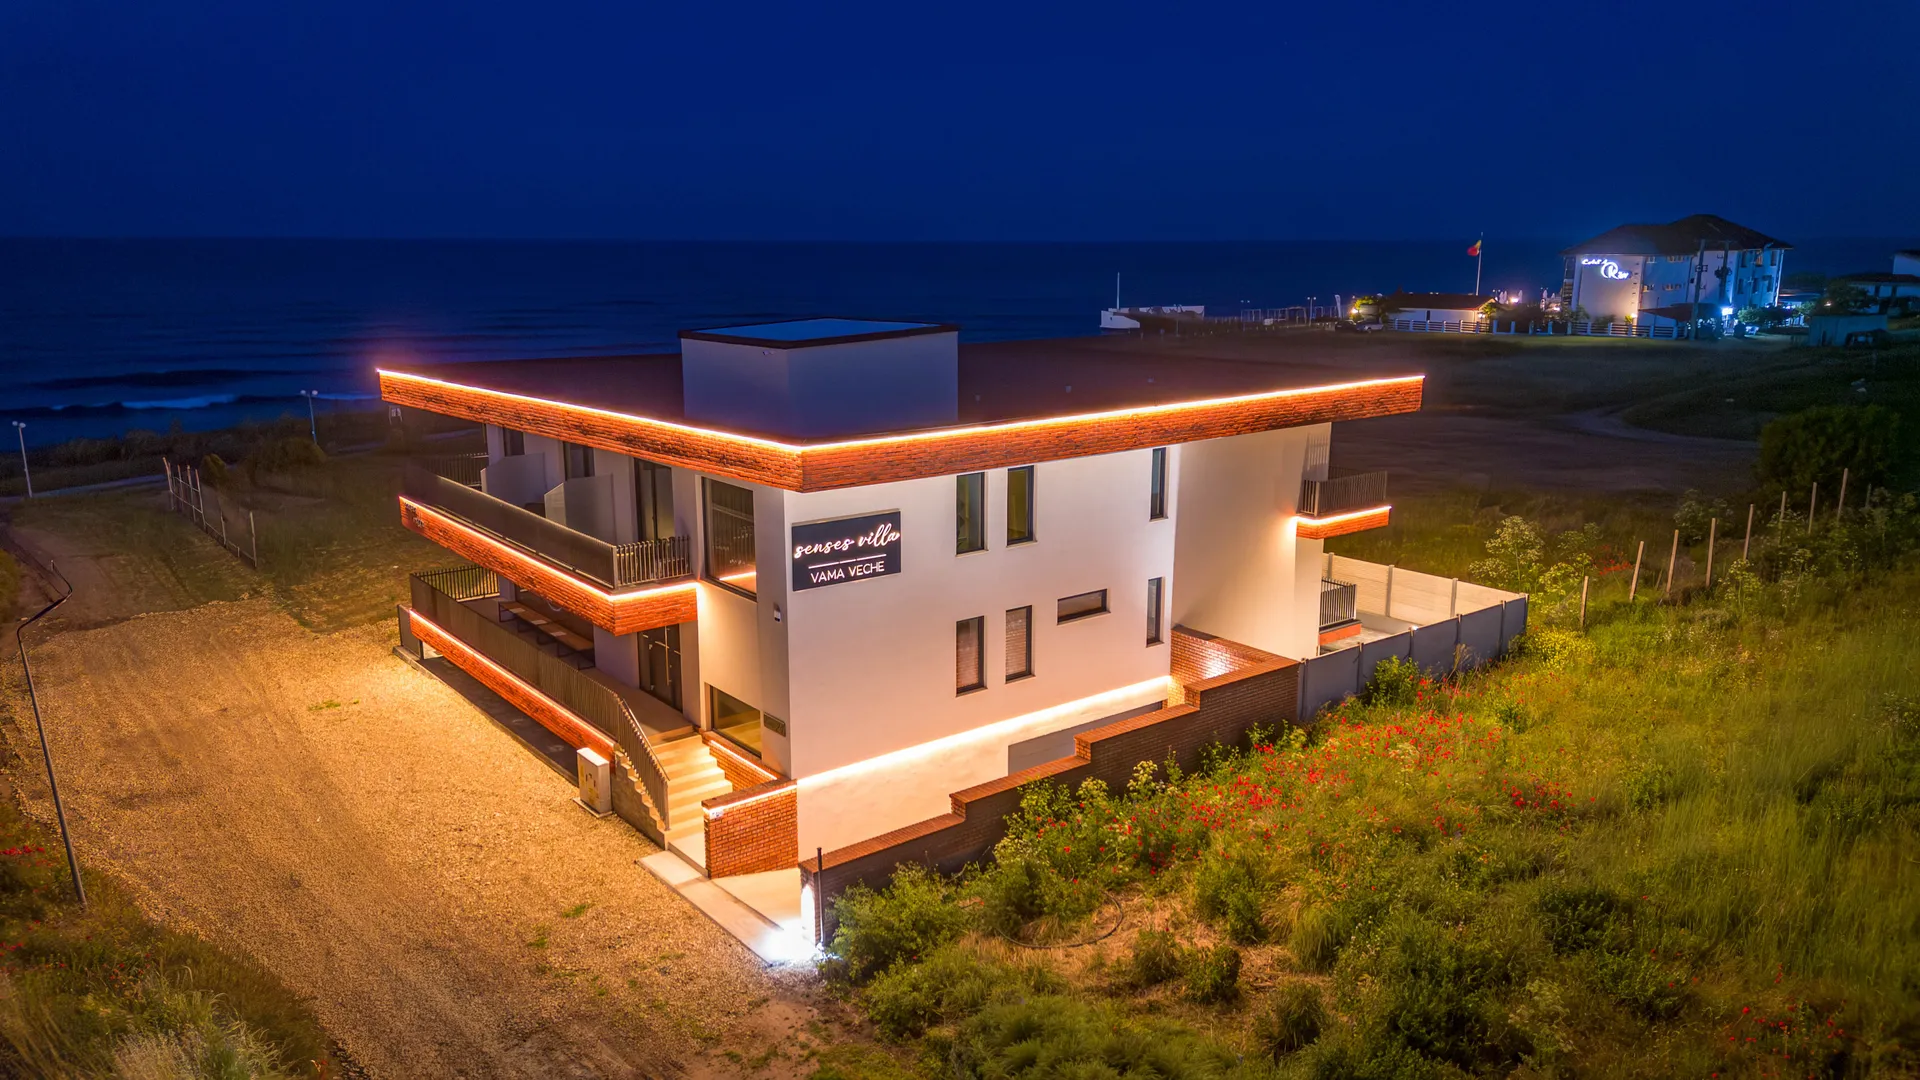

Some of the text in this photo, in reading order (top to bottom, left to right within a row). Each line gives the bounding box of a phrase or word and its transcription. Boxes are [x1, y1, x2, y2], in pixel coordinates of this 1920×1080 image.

[793, 522, 901, 559] senses villa
[810, 561, 885, 583] VAMA VECHE
